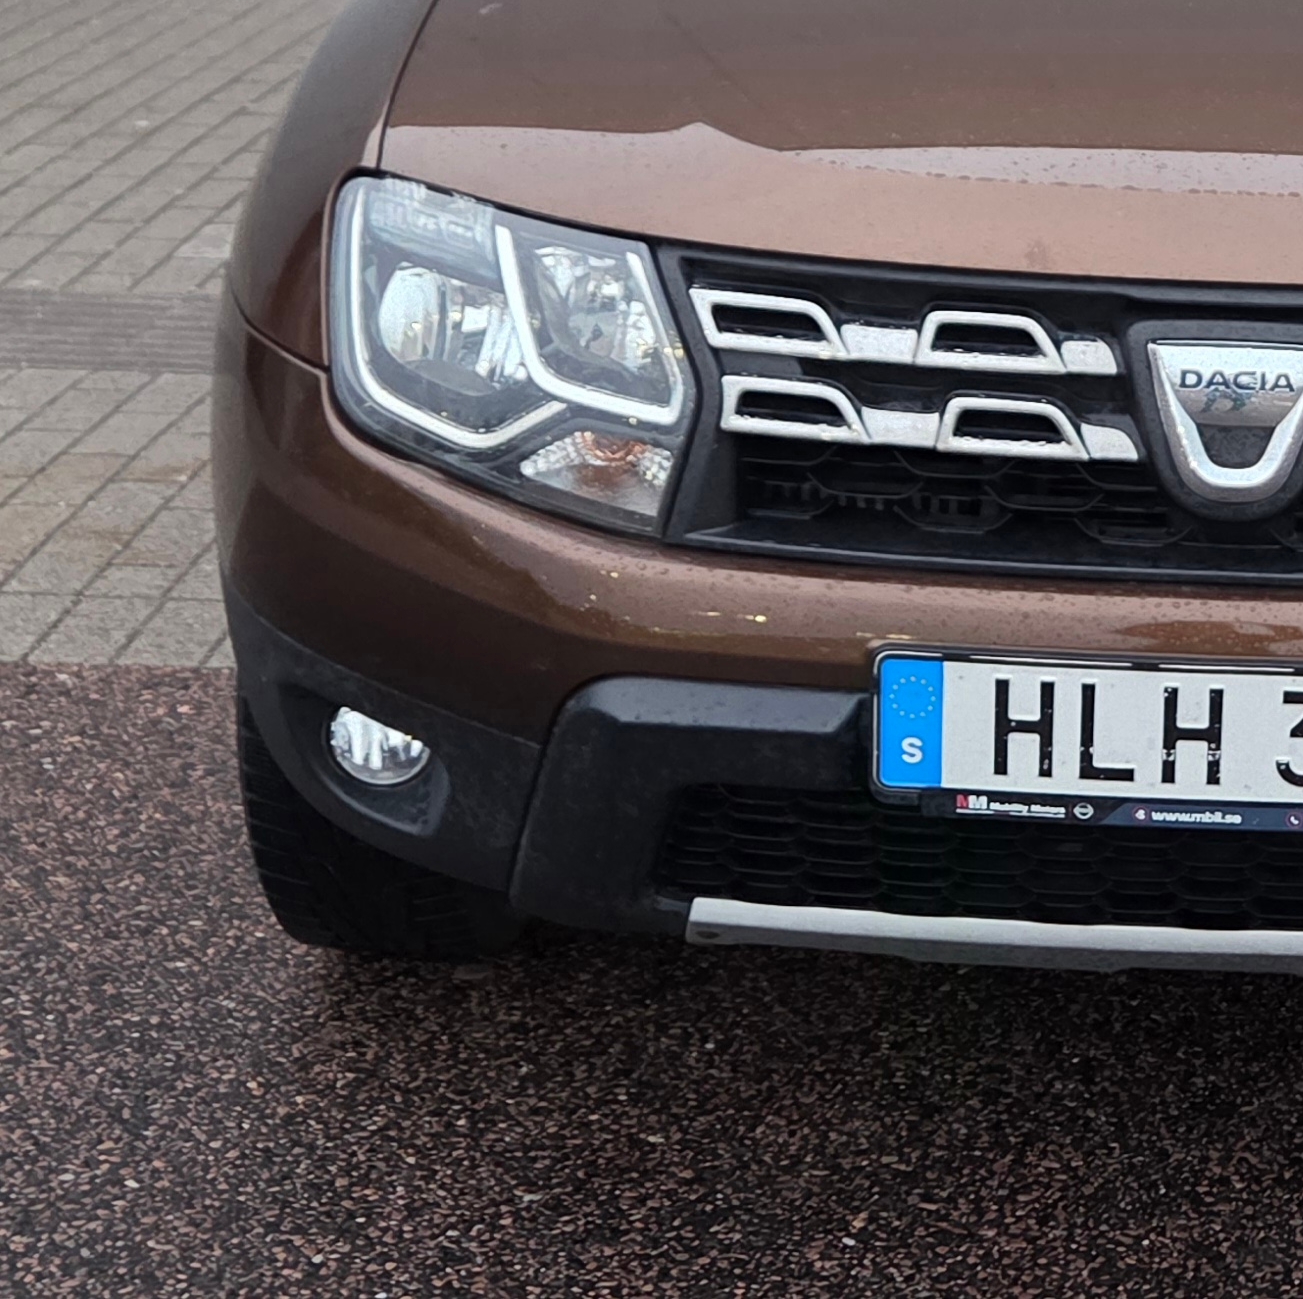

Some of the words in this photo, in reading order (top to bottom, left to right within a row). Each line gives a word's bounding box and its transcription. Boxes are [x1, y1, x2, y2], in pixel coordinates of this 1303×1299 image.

[1178, 368, 1296, 393] DACIA
[993, 677, 1225, 785] HLH
[901, 737, 923, 764] S
